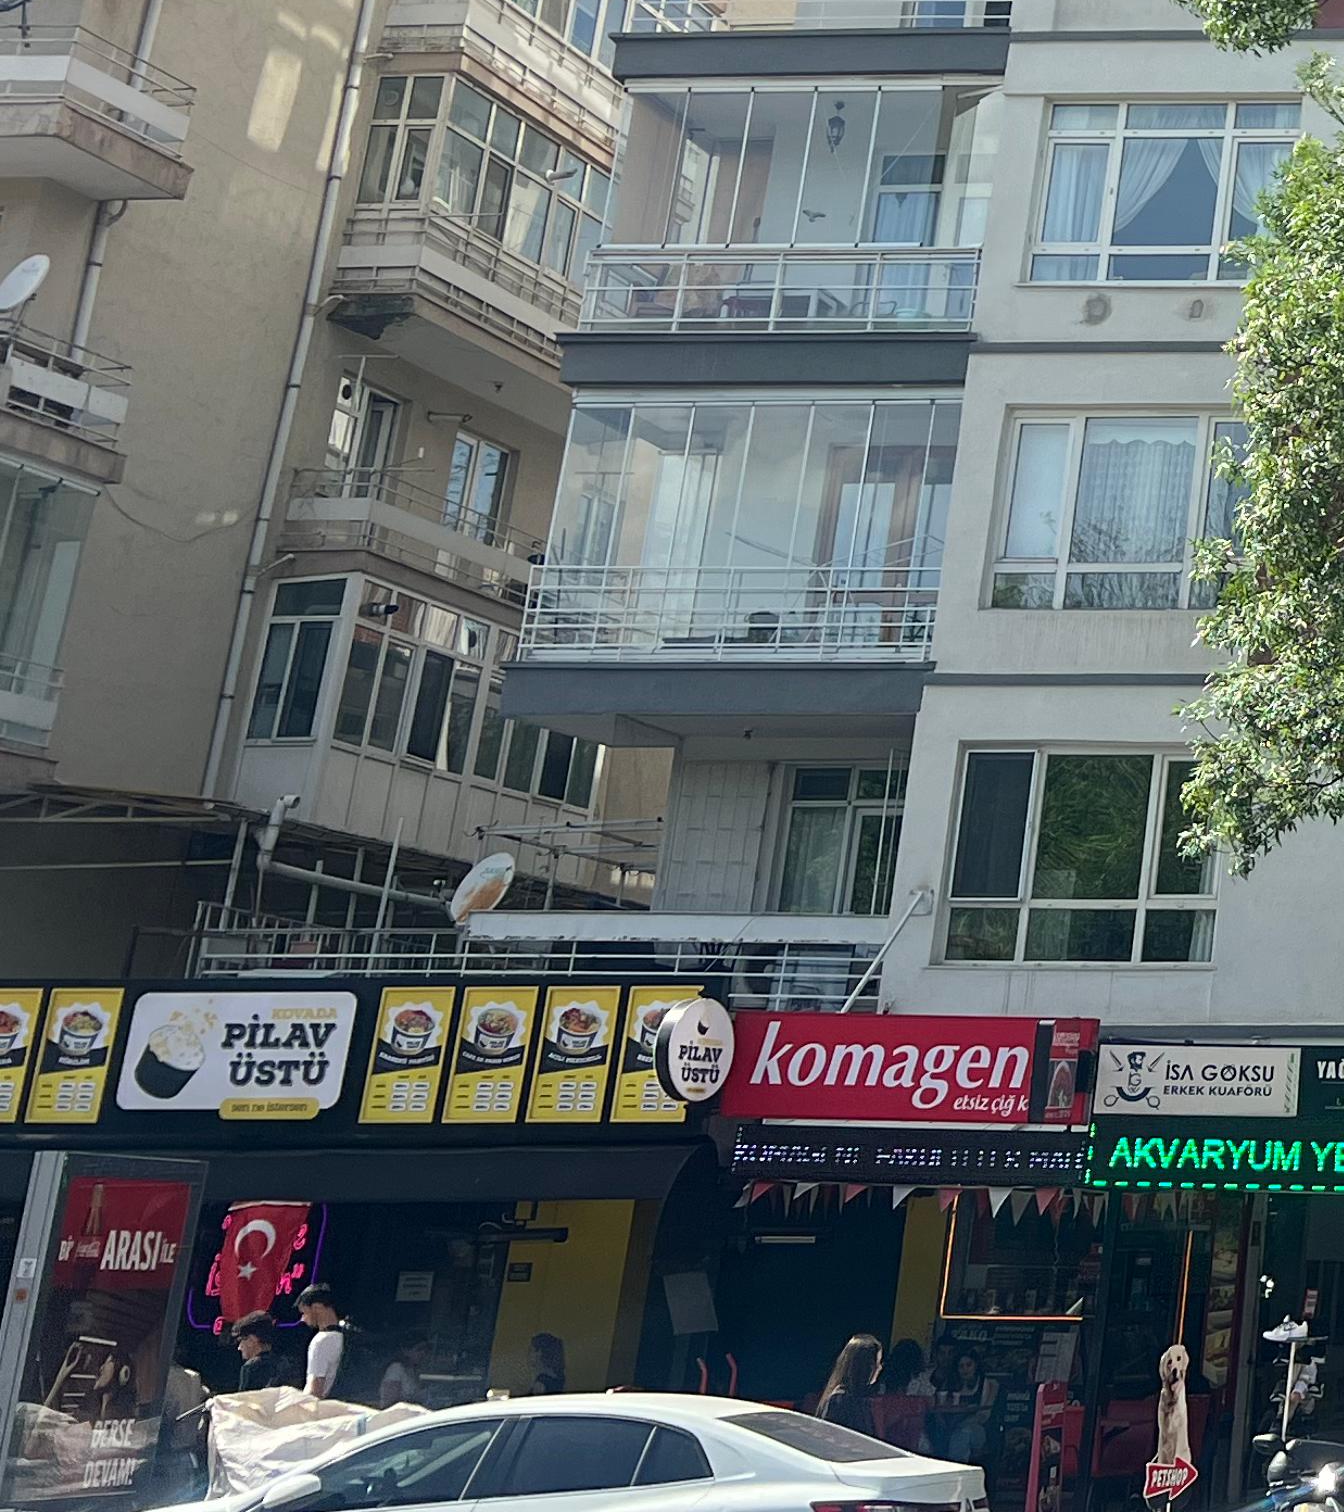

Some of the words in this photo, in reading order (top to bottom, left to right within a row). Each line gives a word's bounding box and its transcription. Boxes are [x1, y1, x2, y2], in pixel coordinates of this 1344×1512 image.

[220, 1013, 338, 1049] PİLAV
[678, 1040, 723, 1063] PİLAV
[749, 1020, 1031, 1110] komagen
[228, 1051, 331, 1087] ÜSTÜ
[681, 1062, 720, 1084] ÜSTÜ
[1165, 1060, 1194, 1081] İSA
[1201, 1063, 1275, 1083] GÖKSU
[1163, 1085, 1204, 1096] ERKEK
[953, 1093, 992, 1111] etsiz
[990, 1094, 1016, 1118] çiğ
[1108, 1137, 1302, 1172] AKVARYUM
[100, 1229, 163, 1271] ARASI
[83, 1457, 136, 1488] DEVAM!
[1150, 1467, 1188, 1489] PETSHOP
